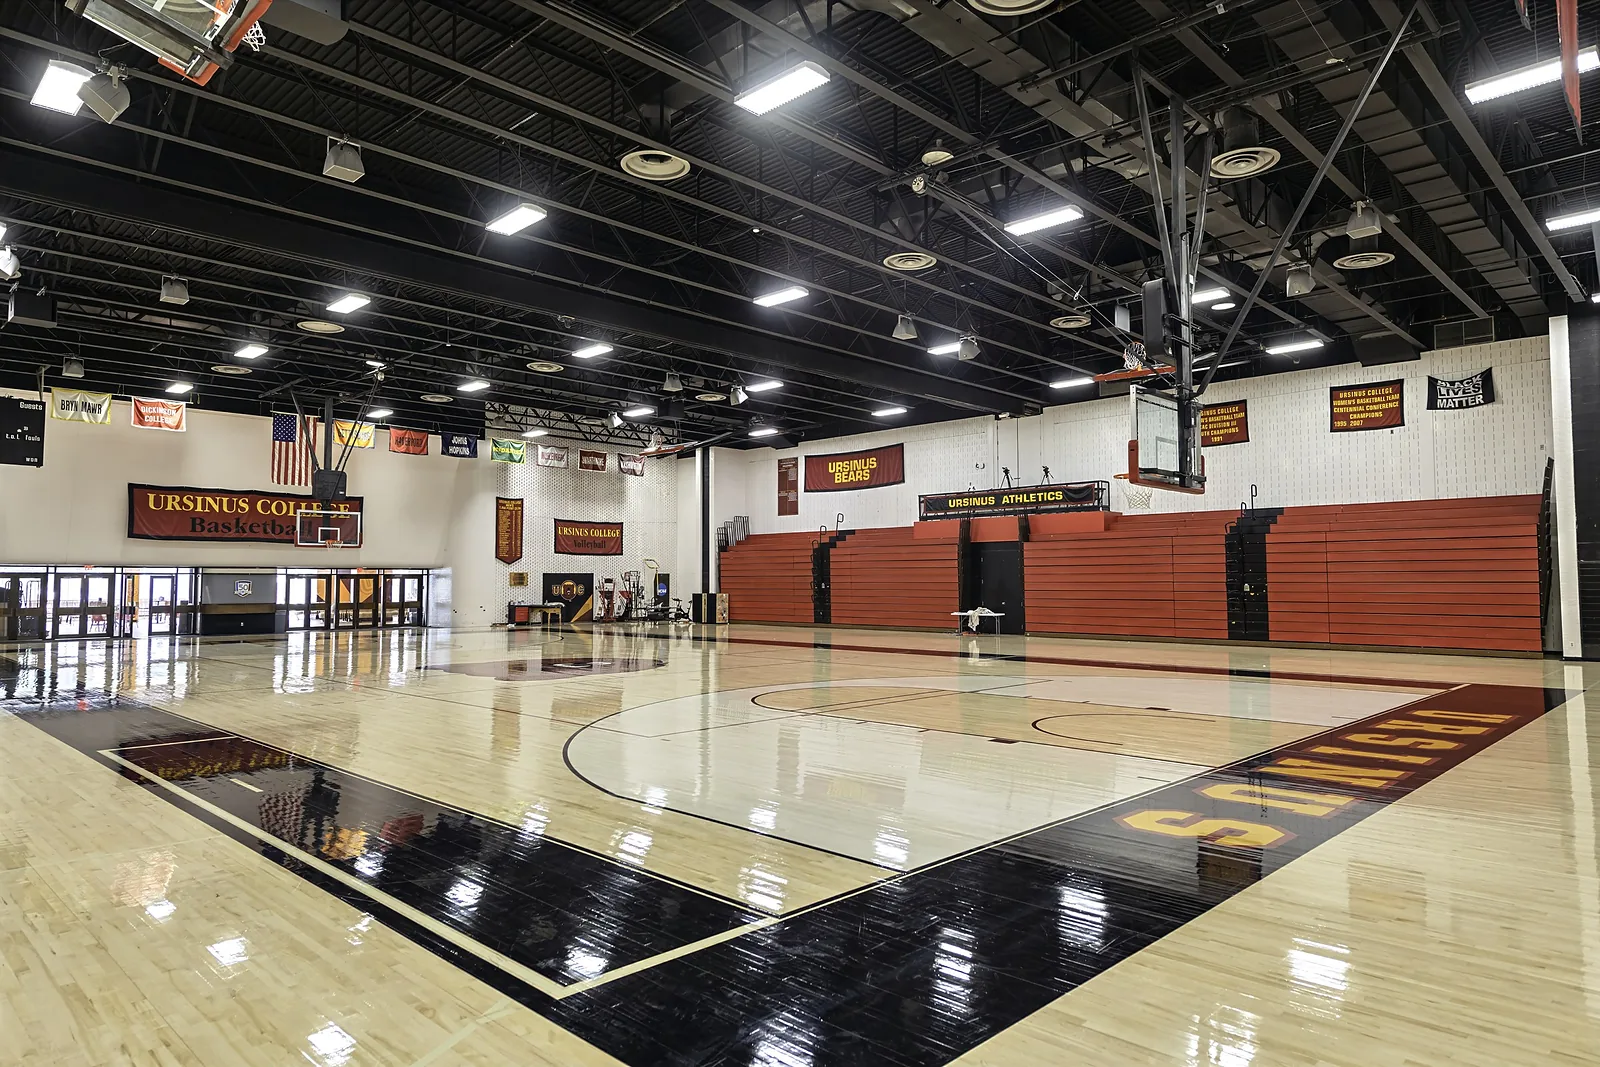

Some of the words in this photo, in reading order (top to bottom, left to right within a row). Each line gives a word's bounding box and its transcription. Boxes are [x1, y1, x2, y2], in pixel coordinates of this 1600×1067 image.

[1437, 374, 1483, 388] BLACK
[1340, 390, 1366, 399] URSINUS
[1367, 387, 1393, 396] COLLEGE
[1438, 382, 1482, 397] LIVES
[1333, 398, 1356, 406] WOMEN'S
[1357, 396, 1386, 404] BASKETBALL
[1386, 393, 1400, 401] TEAM
[1437, 395, 1484, 408] MATTER
[20, 402, 43, 411] Guests
[60, 399, 78, 412] BRYN
[81, 401, 103, 415] MAWR
[141, 406, 177, 416] DICKINSON
[1333, 405, 1365, 413] CENTENNIAL
[1366, 401, 1399, 411] CONFERENCE
[1349, 411, 1383, 420] CHAMPIONS
[1209, 421, 1231, 429] DIVISION
[1210, 427, 1239, 435] CHAMPIONS
[451, 435, 468, 445] JOHNS
[448, 446, 471, 456] HOPKINS
[828, 457, 877, 473] URSINUS
[834, 469, 870, 484] BEARS
[147, 492, 250, 514] URSINUS
[948, 496, 995, 508] URSINUS
[1001, 491, 1064, 505] ATHLETICS
[189, 516, 313, 538] Basketball
[558, 526, 589, 537] URSINUS
[590, 527, 621, 538] COLLEGE
[573, 539, 606, 550] Volleyball
[1112, 709, 1523, 849] URSINUS
